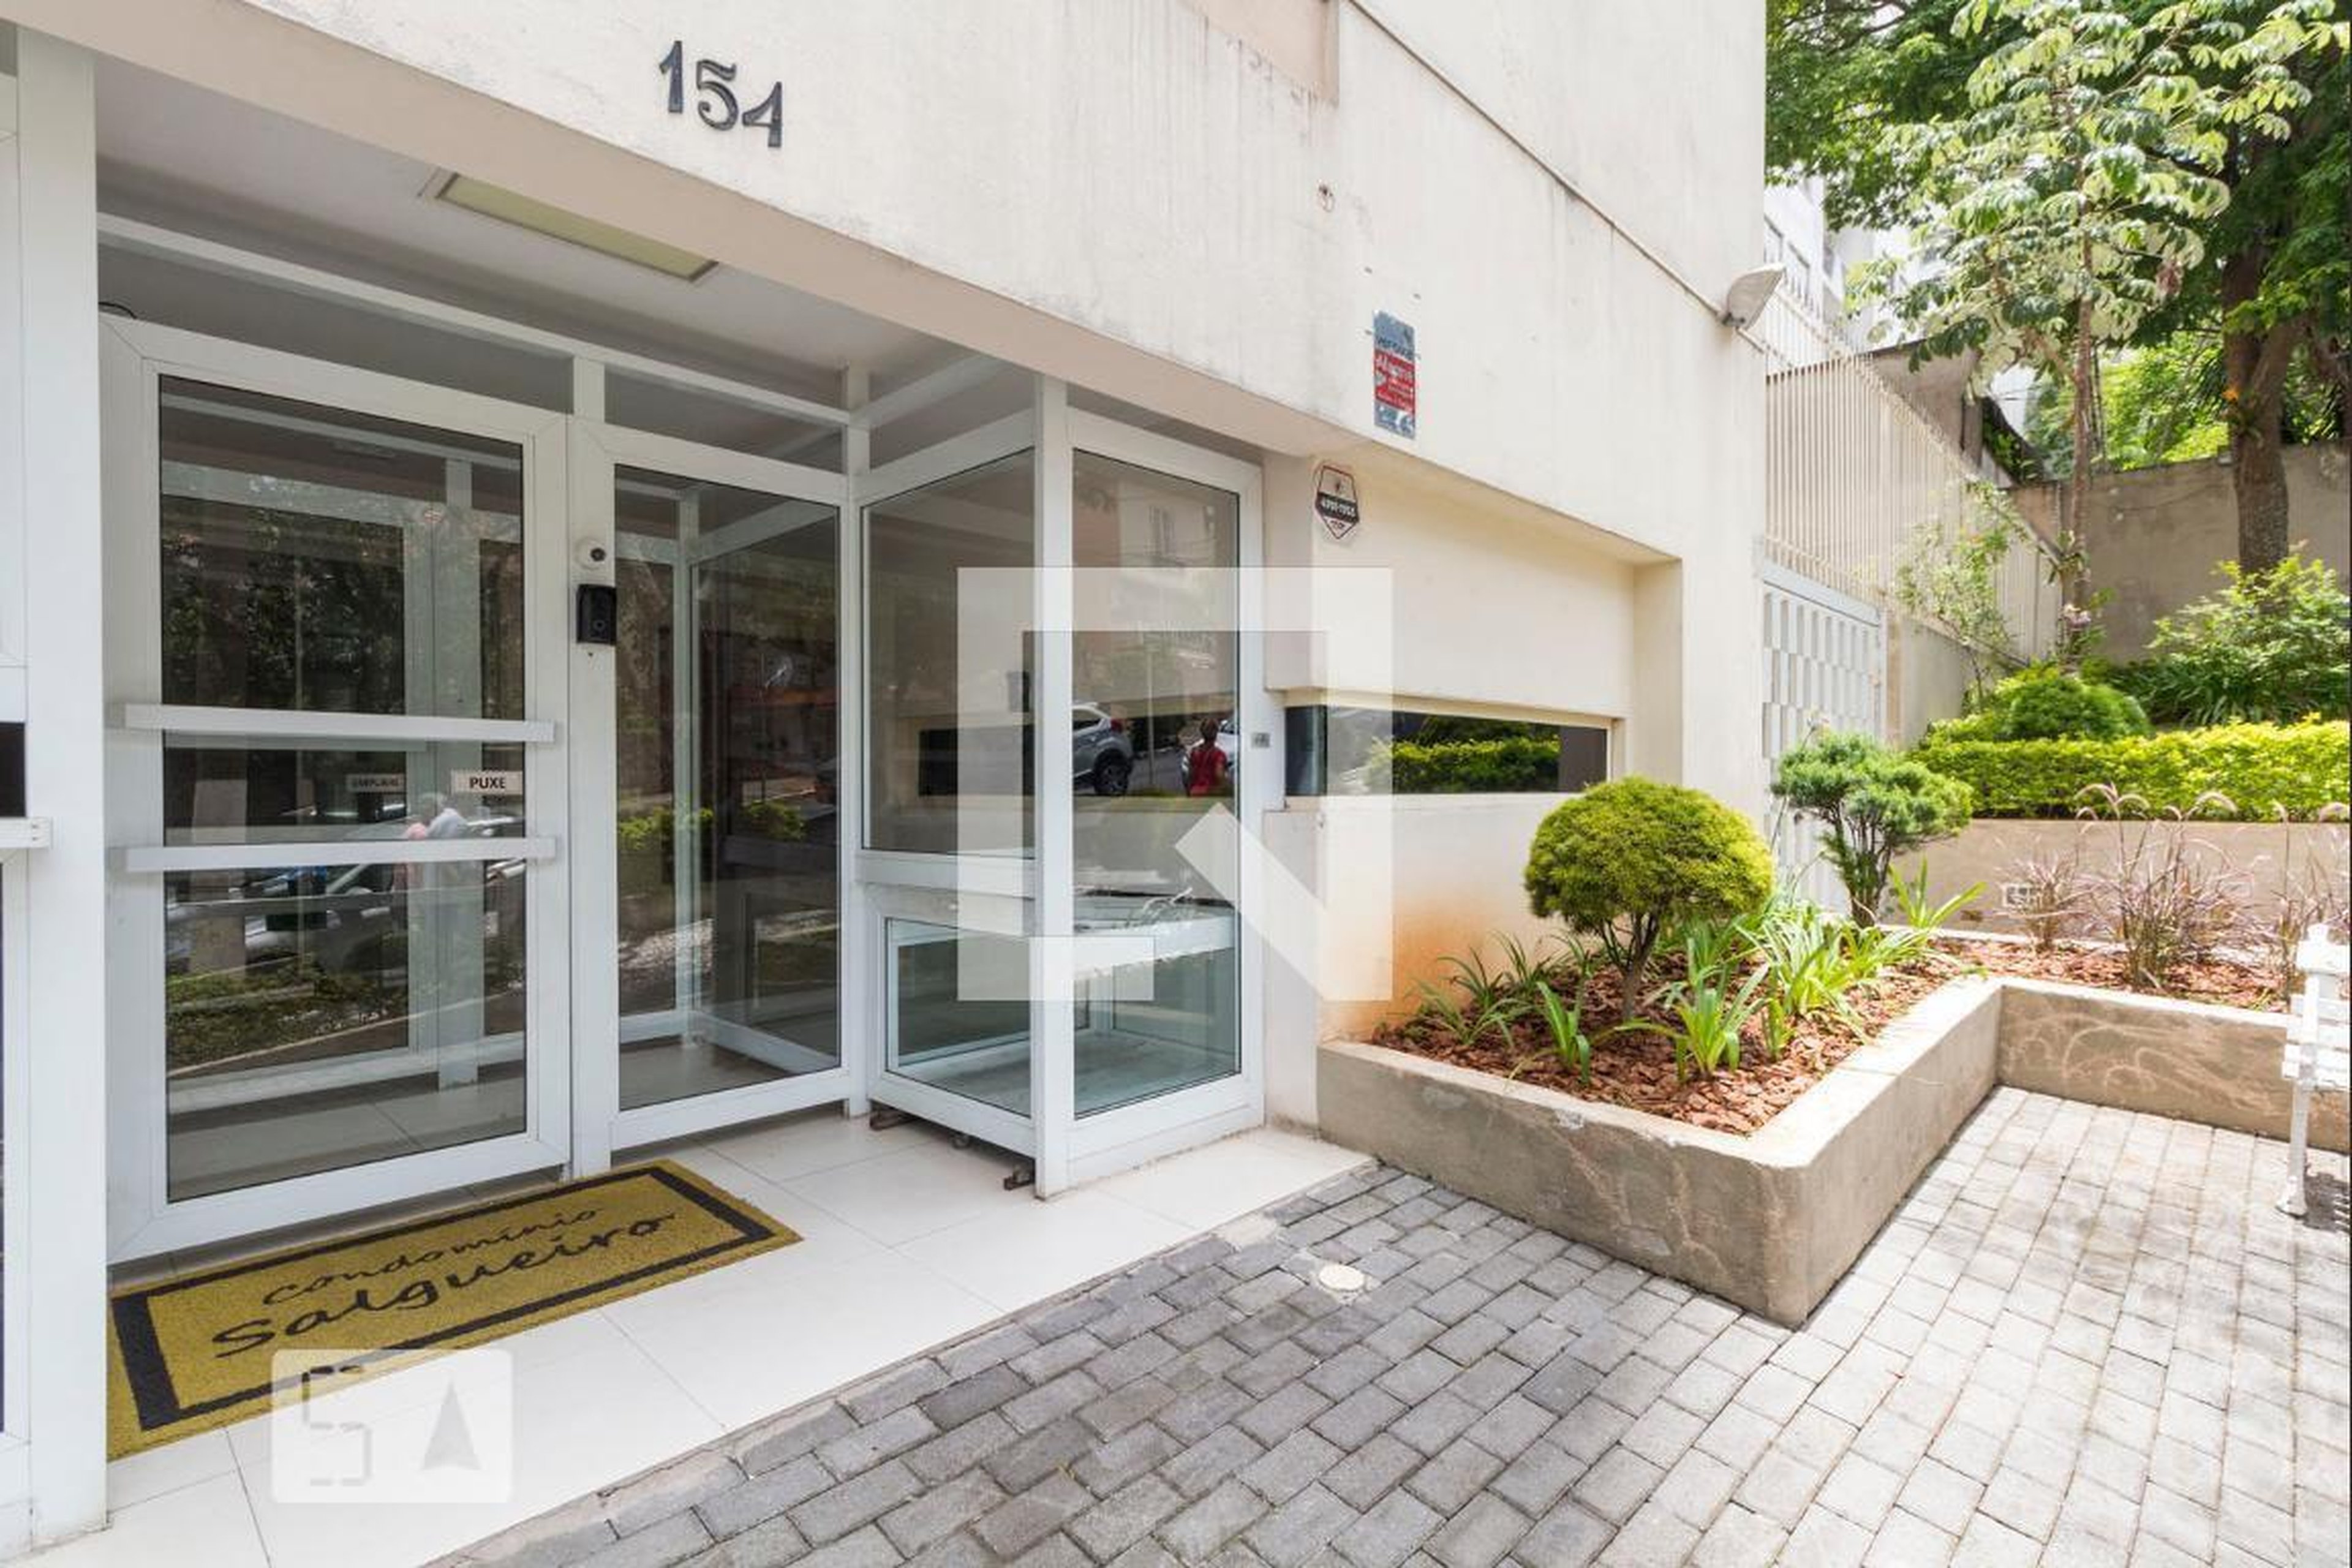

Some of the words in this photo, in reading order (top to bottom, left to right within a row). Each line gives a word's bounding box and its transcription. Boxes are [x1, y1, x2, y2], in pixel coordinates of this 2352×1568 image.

[659, 40, 782, 148] 154
[470, 777, 506, 789] PUXE
[212, 1211, 675, 1359] Salgueiro
